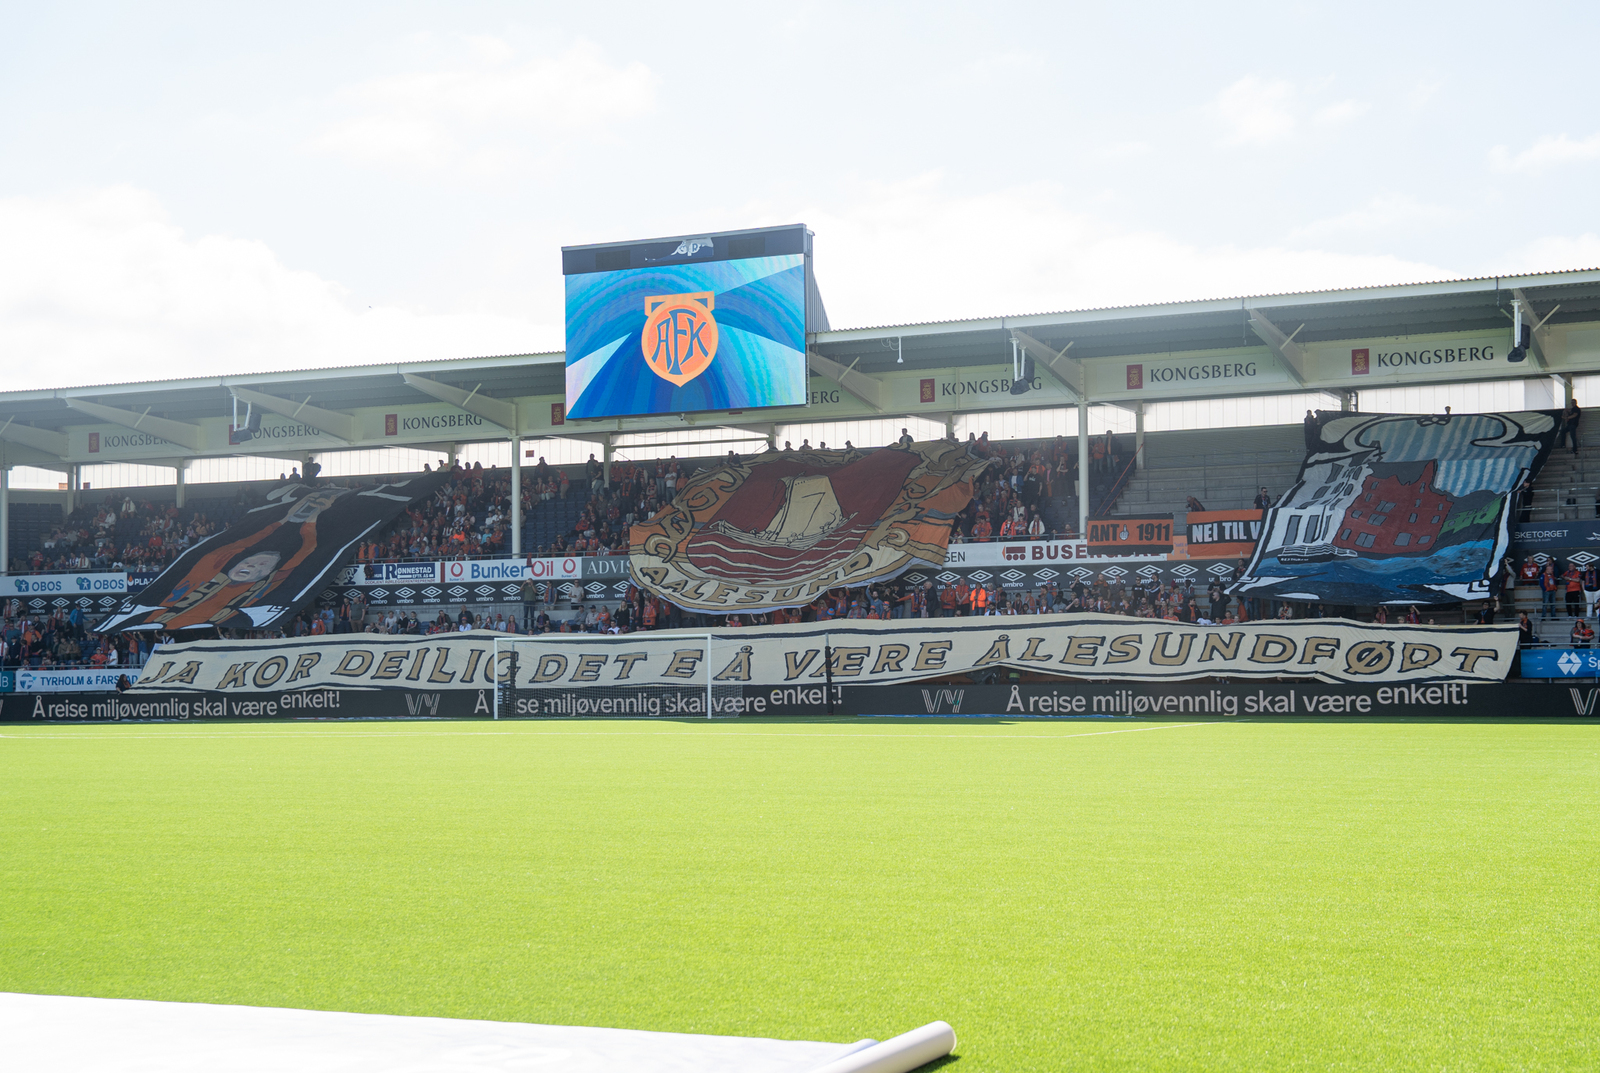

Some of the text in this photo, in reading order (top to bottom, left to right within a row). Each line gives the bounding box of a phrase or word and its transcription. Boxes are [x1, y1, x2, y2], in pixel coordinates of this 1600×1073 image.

[651, 308, 709, 375] AFK
[1377, 346, 1495, 368] KONGSBERG
[1150, 362, 1257, 383] KONGSBERG
[942, 376, 1042, 396] KONGSBG
[253, 424, 320, 439] ONGSBERG
[403, 413, 483, 430] KONGSBERG
[1090, 522, 1170, 543] ANT 1911
[1192, 521, 1261, 543] NEI TIL V
[1514, 530, 1568, 539] SKETORGET
[587, 560, 630, 575] ADVIS
[31, 581, 62, 592] OBOS
[94, 579, 125, 590] OBOS
[640, 552, 873, 606] AALESUND
[138, 632, 1498, 690] JA KOR DEILIG DET E Å VÆRE ÅLESUNDFØDT
[40, 675, 138, 686] TYRHOLM & FARSAD
[32, 691, 340, 720] Å reise miljøvennlig skal være enkelt!
[474, 689, 490, 714] Å
[544, 693, 660, 717] miljøvennlig
[665, 692, 706, 713] skal
[712, 696, 767, 713] være
[1006, 683, 1468, 716] Å reise miljøvennlig skal være enkelt!
